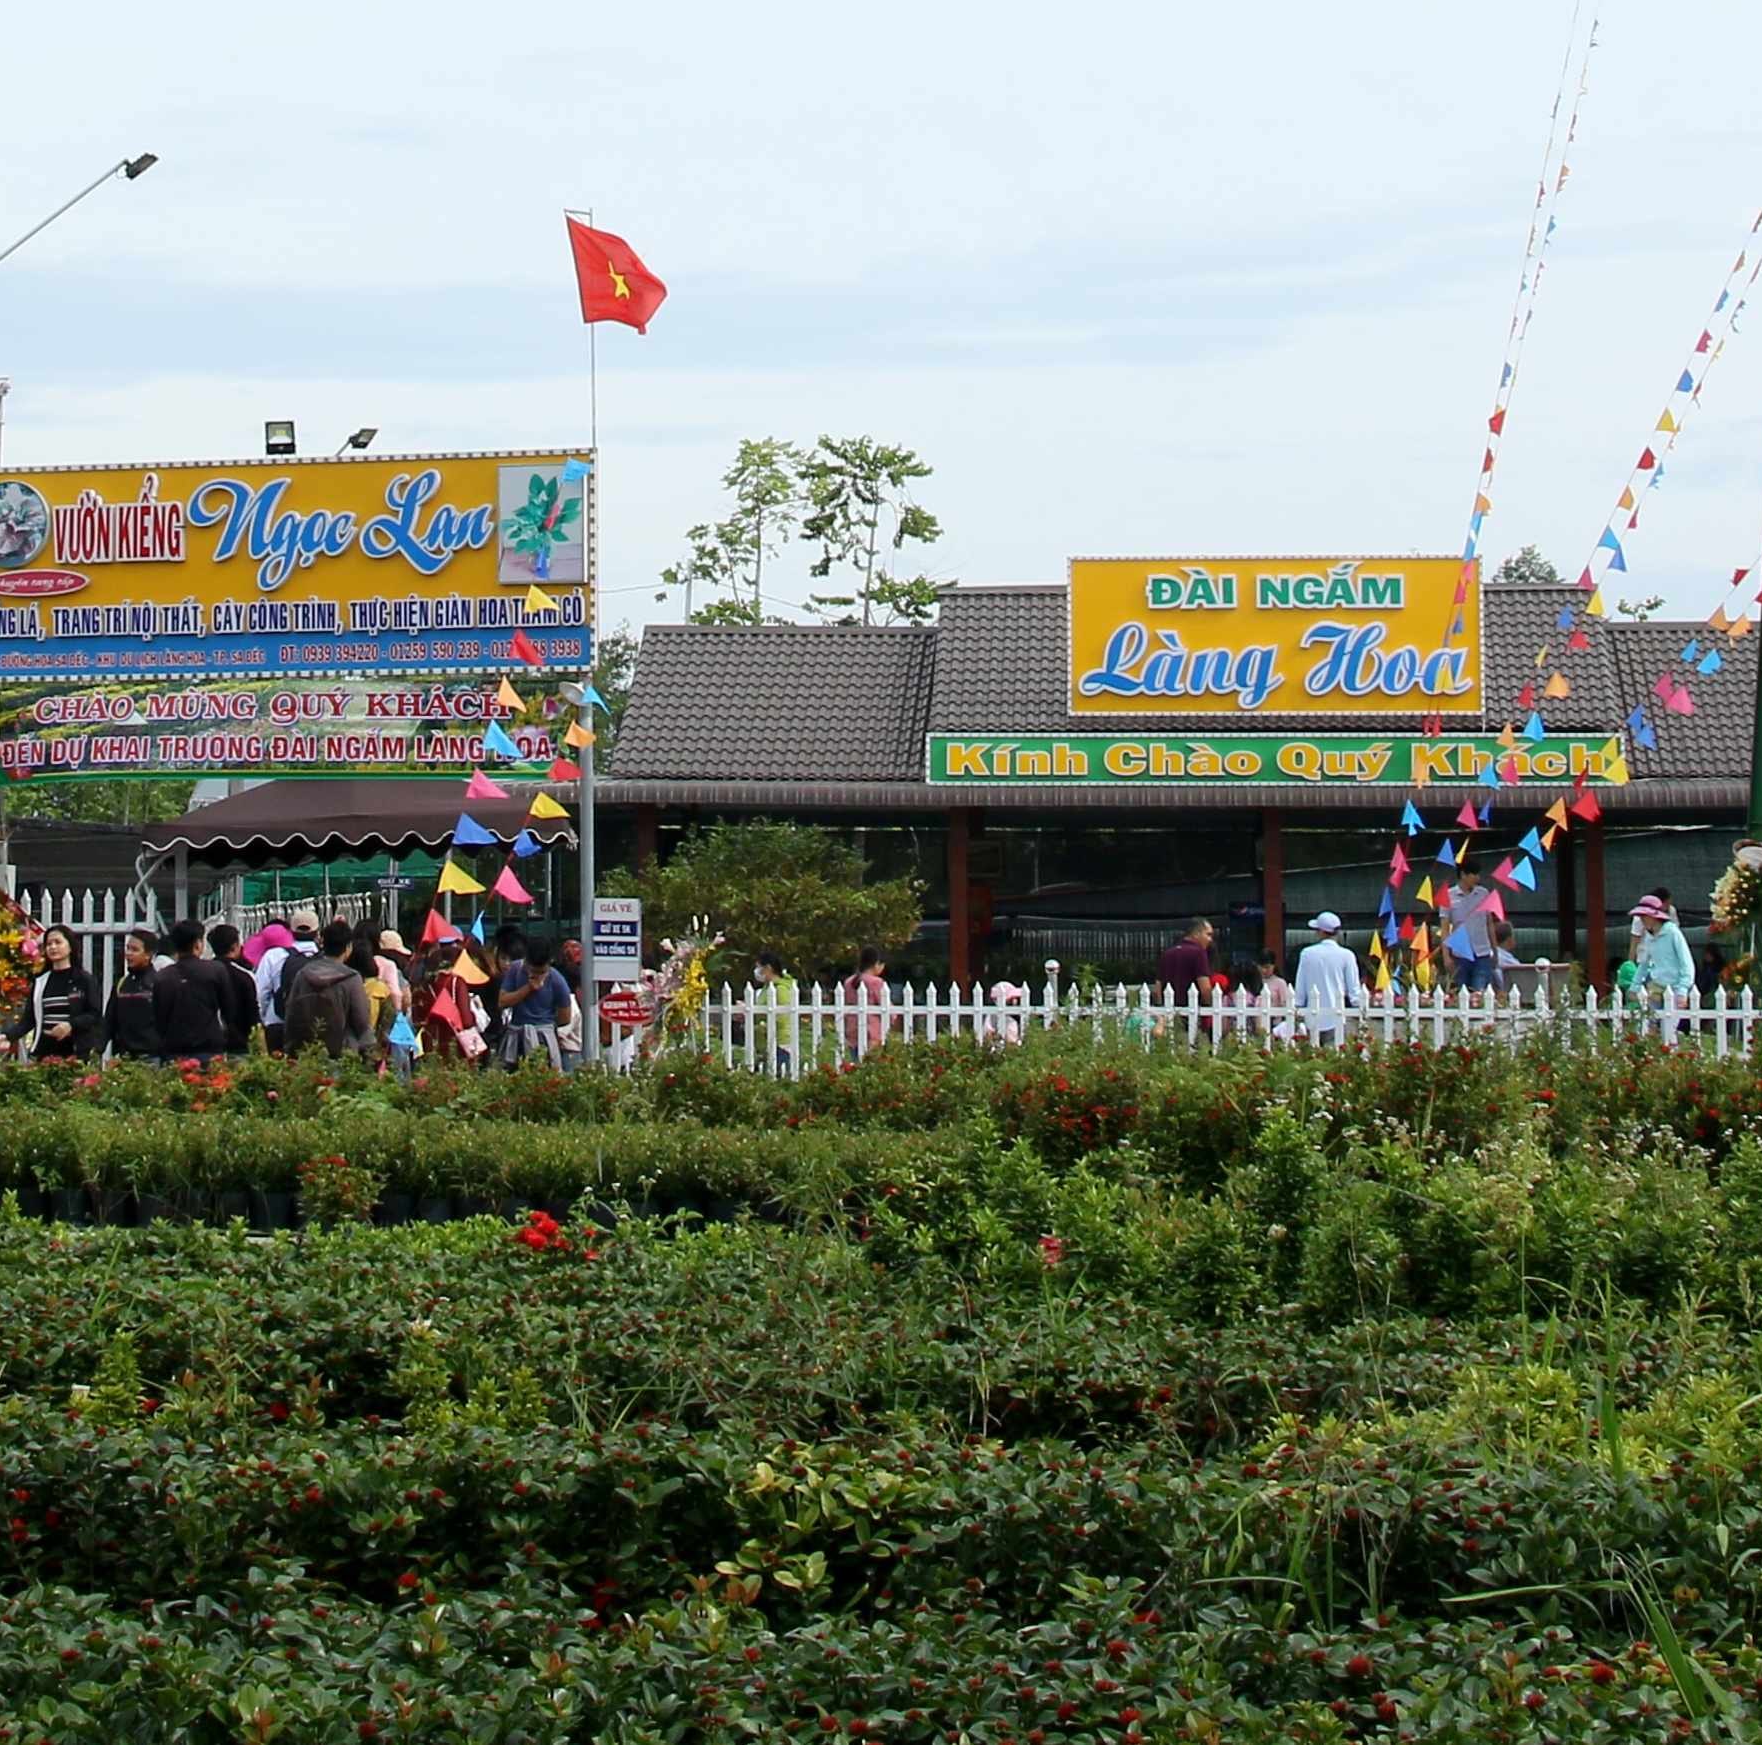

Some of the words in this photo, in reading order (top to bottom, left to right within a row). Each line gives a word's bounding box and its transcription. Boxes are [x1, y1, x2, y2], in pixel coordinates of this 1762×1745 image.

[54, 490, 111, 563] VƯỜN
[116, 472, 186, 561] KIỂNG
[187, 477, 357, 591] Ngọc
[360, 468, 496, 575] Lan
[1146, 567, 1238, 609] ĐÀI
[1256, 561, 1405, 609] NGẮM
[52, 606, 102, 636] TRANG
[105, 600, 130, 635] TRÍ
[131, 599, 158, 641] NỘI
[213, 597, 246, 634] CÂY
[247, 596, 290, 633] CÔNG
[292, 595, 344, 635] TRÌNH,
[349, 595, 390, 636] THỰC
[392, 593, 432, 636] HIỆN
[434, 592, 474, 630] GIÀN
[477, 596, 511, 628] HOA
[561, 586, 585, 626] CỎ
[95, 652, 117, 667] KHU
[301, 644, 332, 662] 0939
[335, 642, 379, 662] 394220
[431, 641, 455, 660] 590
[457, 640, 480, 659] 239
[550, 637, 581, 658] 3938
[1078, 621, 1286, 709] Làng
[1300, 621, 1472, 697] Hoa
[35, 691, 134, 723] CHÀO
[146, 686, 258, 722] MỪNG
[269, 683, 351, 726] QUÝ
[365, 685, 511, 719] KHÁCH
[1, 732, 46, 767] ĐẾN
[50, 734, 87, 770] DỰ
[90, 735, 150, 763] KHAI
[270, 728, 317, 762] ĐÀI
[325, 727, 406, 762] NGẮM
[414, 729, 485, 762] LÀNG
[494, 734, 553, 762] OA
[944, 742, 1089, 777] Kính
[1102, 742, 1262, 777] Chào
[1276, 742, 1392, 782] Quý
[1411, 742, 1605, 777] Khách
